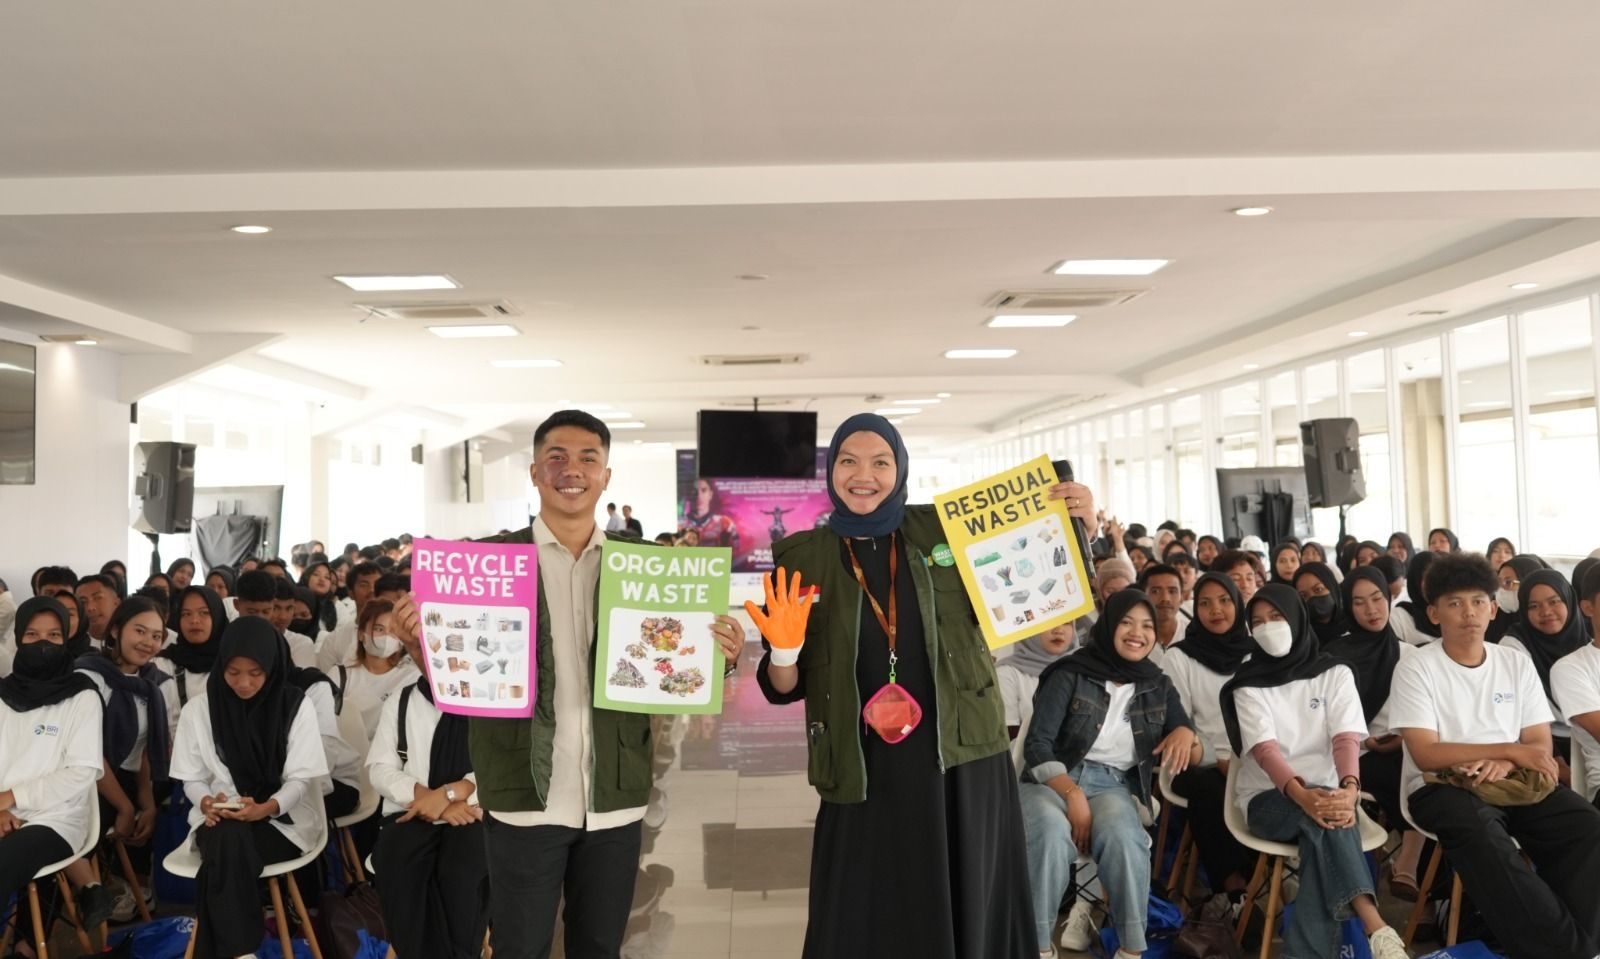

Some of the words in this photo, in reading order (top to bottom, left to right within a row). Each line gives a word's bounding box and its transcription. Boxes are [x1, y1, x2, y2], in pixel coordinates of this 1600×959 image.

[943, 467, 1052, 520] RESIDUAL
[964, 492, 1046, 536] WASTE
[416, 549, 528, 576] RECYCLE
[608, 552, 725, 577] ORGANIC
[433, 574, 514, 597] WASTE
[621, 580, 709, 604] WASTE
